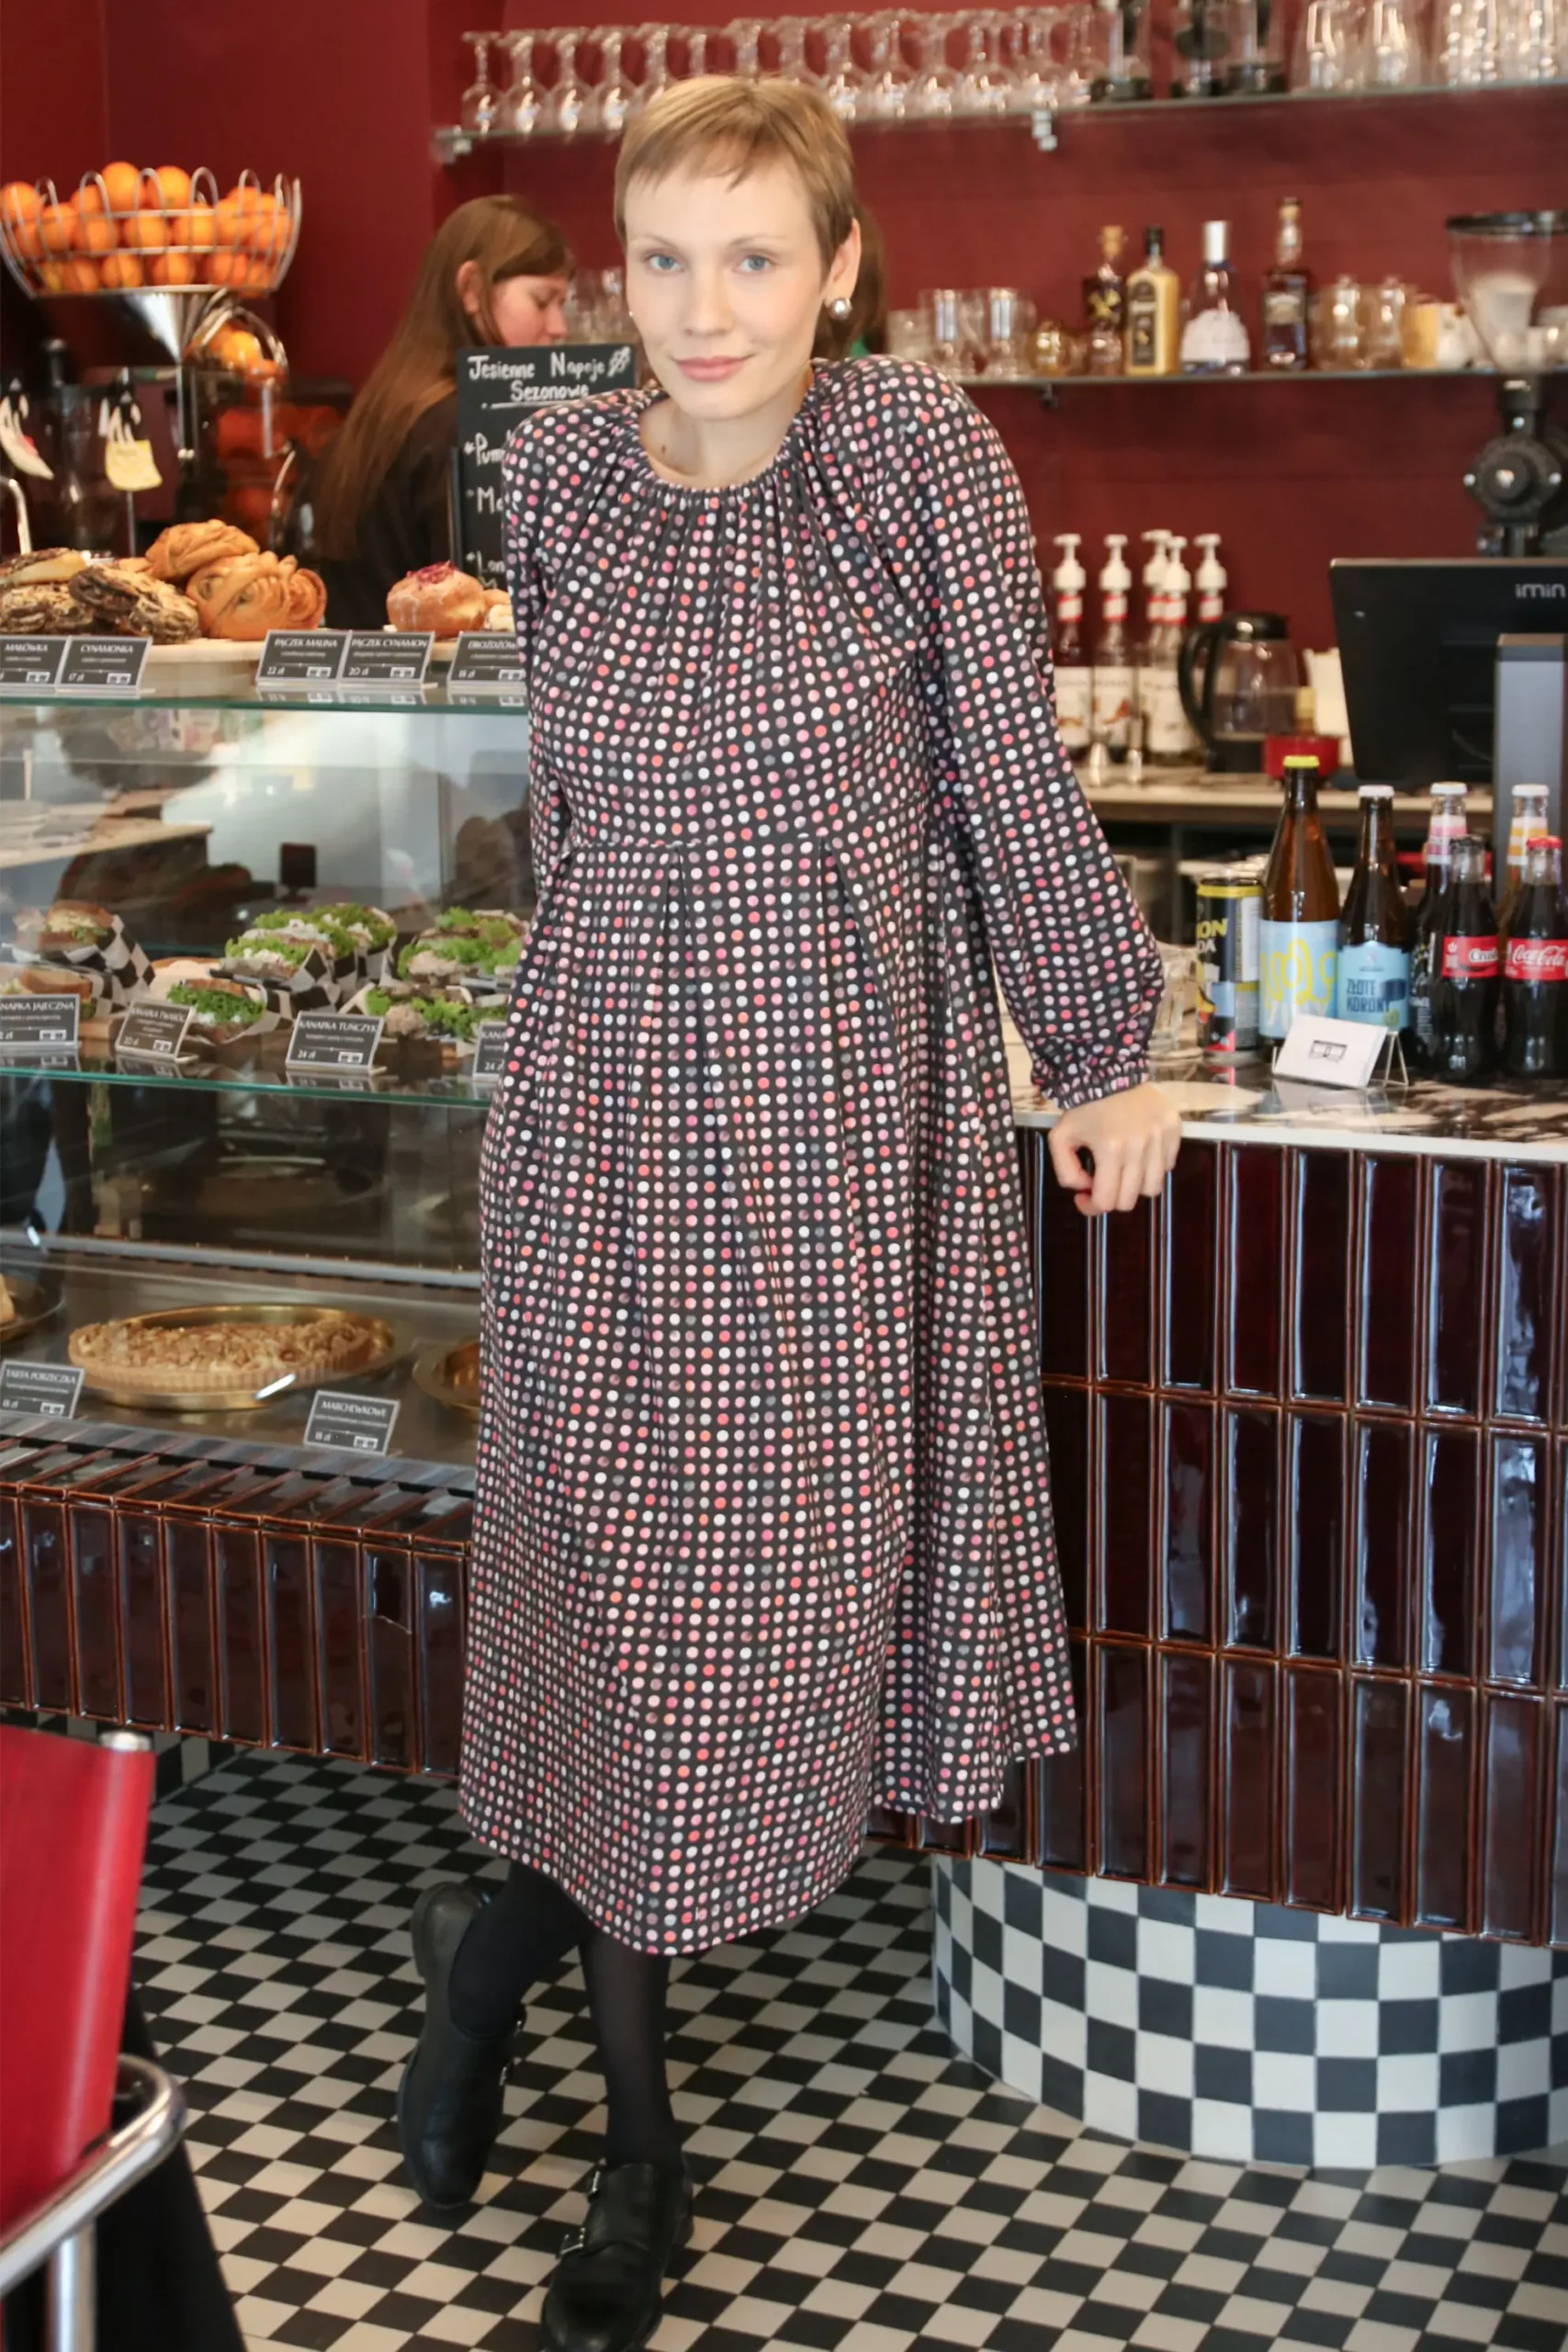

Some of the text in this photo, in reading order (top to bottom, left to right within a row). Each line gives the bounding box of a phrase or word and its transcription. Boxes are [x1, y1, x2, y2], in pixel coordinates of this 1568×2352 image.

[468, 351, 605, 382] Jesienne Napoje
[510, 379, 589, 401] Sezonowe
[80, 643, 134, 653] CYNAMONKA
[1197, 918, 1228, 939] ON
[1347, 978, 1376, 995] ZŁOTE
